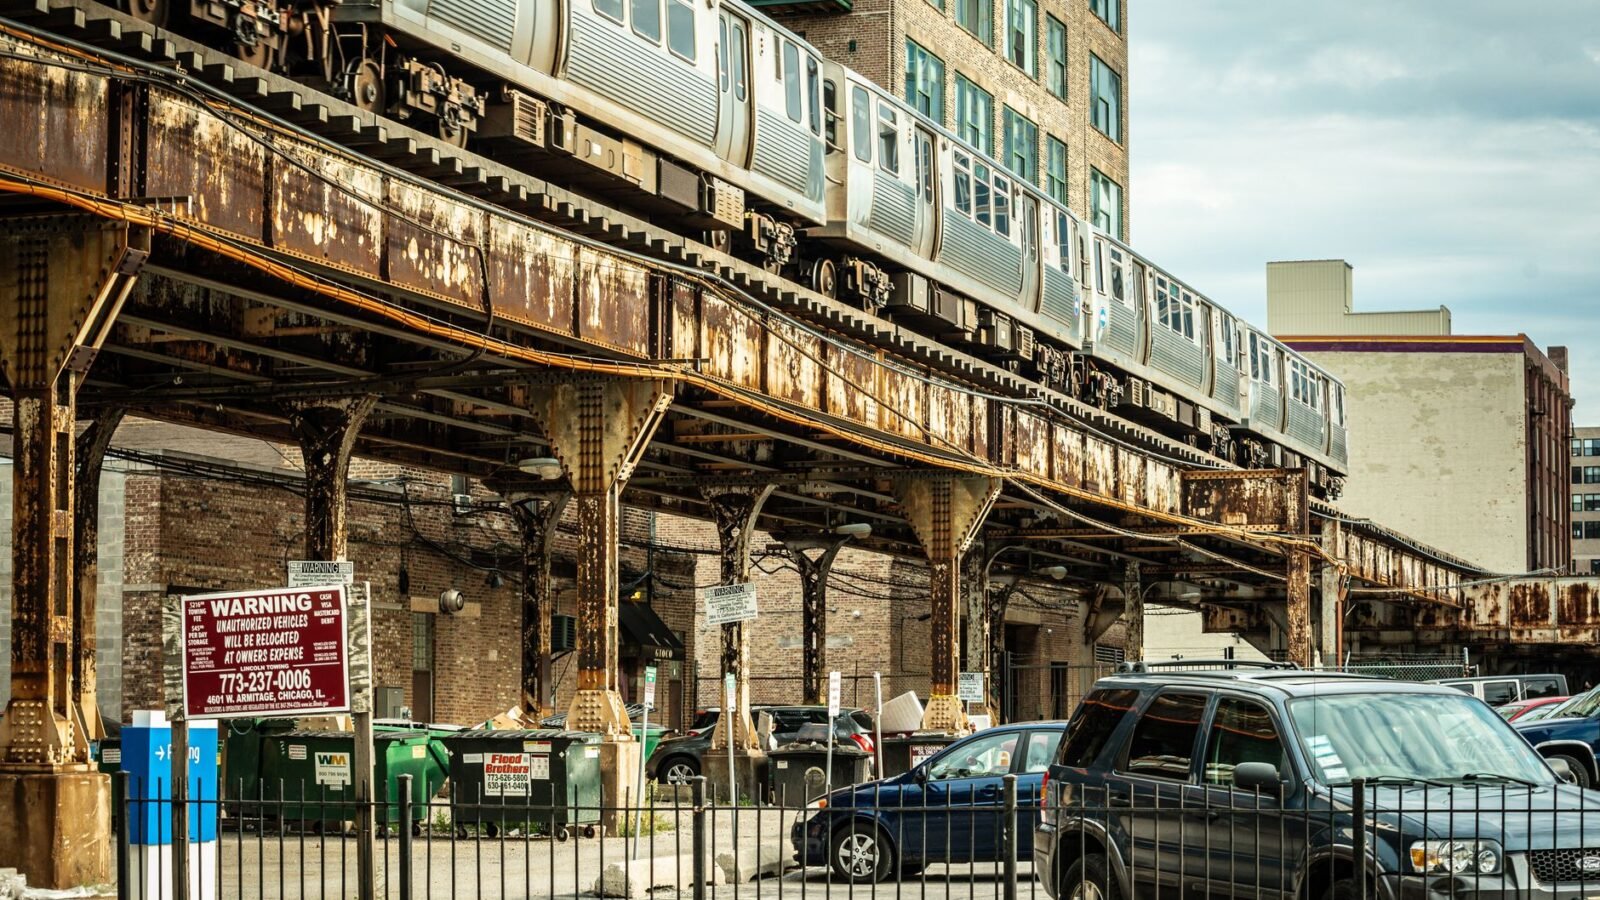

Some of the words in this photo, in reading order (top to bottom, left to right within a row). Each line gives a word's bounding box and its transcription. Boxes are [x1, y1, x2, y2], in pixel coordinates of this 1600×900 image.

[302, 562, 339, 573] WARNING
[714, 585, 744, 596] WARNING
[210, 594, 312, 617] WARNING
[216, 616, 272, 633] UNAUTHORIZED
[274, 614, 308, 629] VEHICLES
[224, 635, 242, 648] WILL
[244, 634, 254, 647] BE
[256, 631, 299, 646] RELOCATED
[224, 650, 234, 664] AT
[236, 649, 267, 663] OWNERS
[270, 647, 304, 661] EXPENSE
[655, 649, 673, 658] GIOCO
[219, 668, 311, 694] 773-237-0006
[207, 695, 224, 704] 4601
[226, 694, 235, 703] W.
[236, 692, 276, 702] ARMITAGE,
[278, 690, 314, 700] CHICAGO,
[316, 689, 325, 698] IL.
[318, 755, 346, 765] WM
[491, 754, 522, 764] Flood
[486, 764, 529, 773] Brothers
